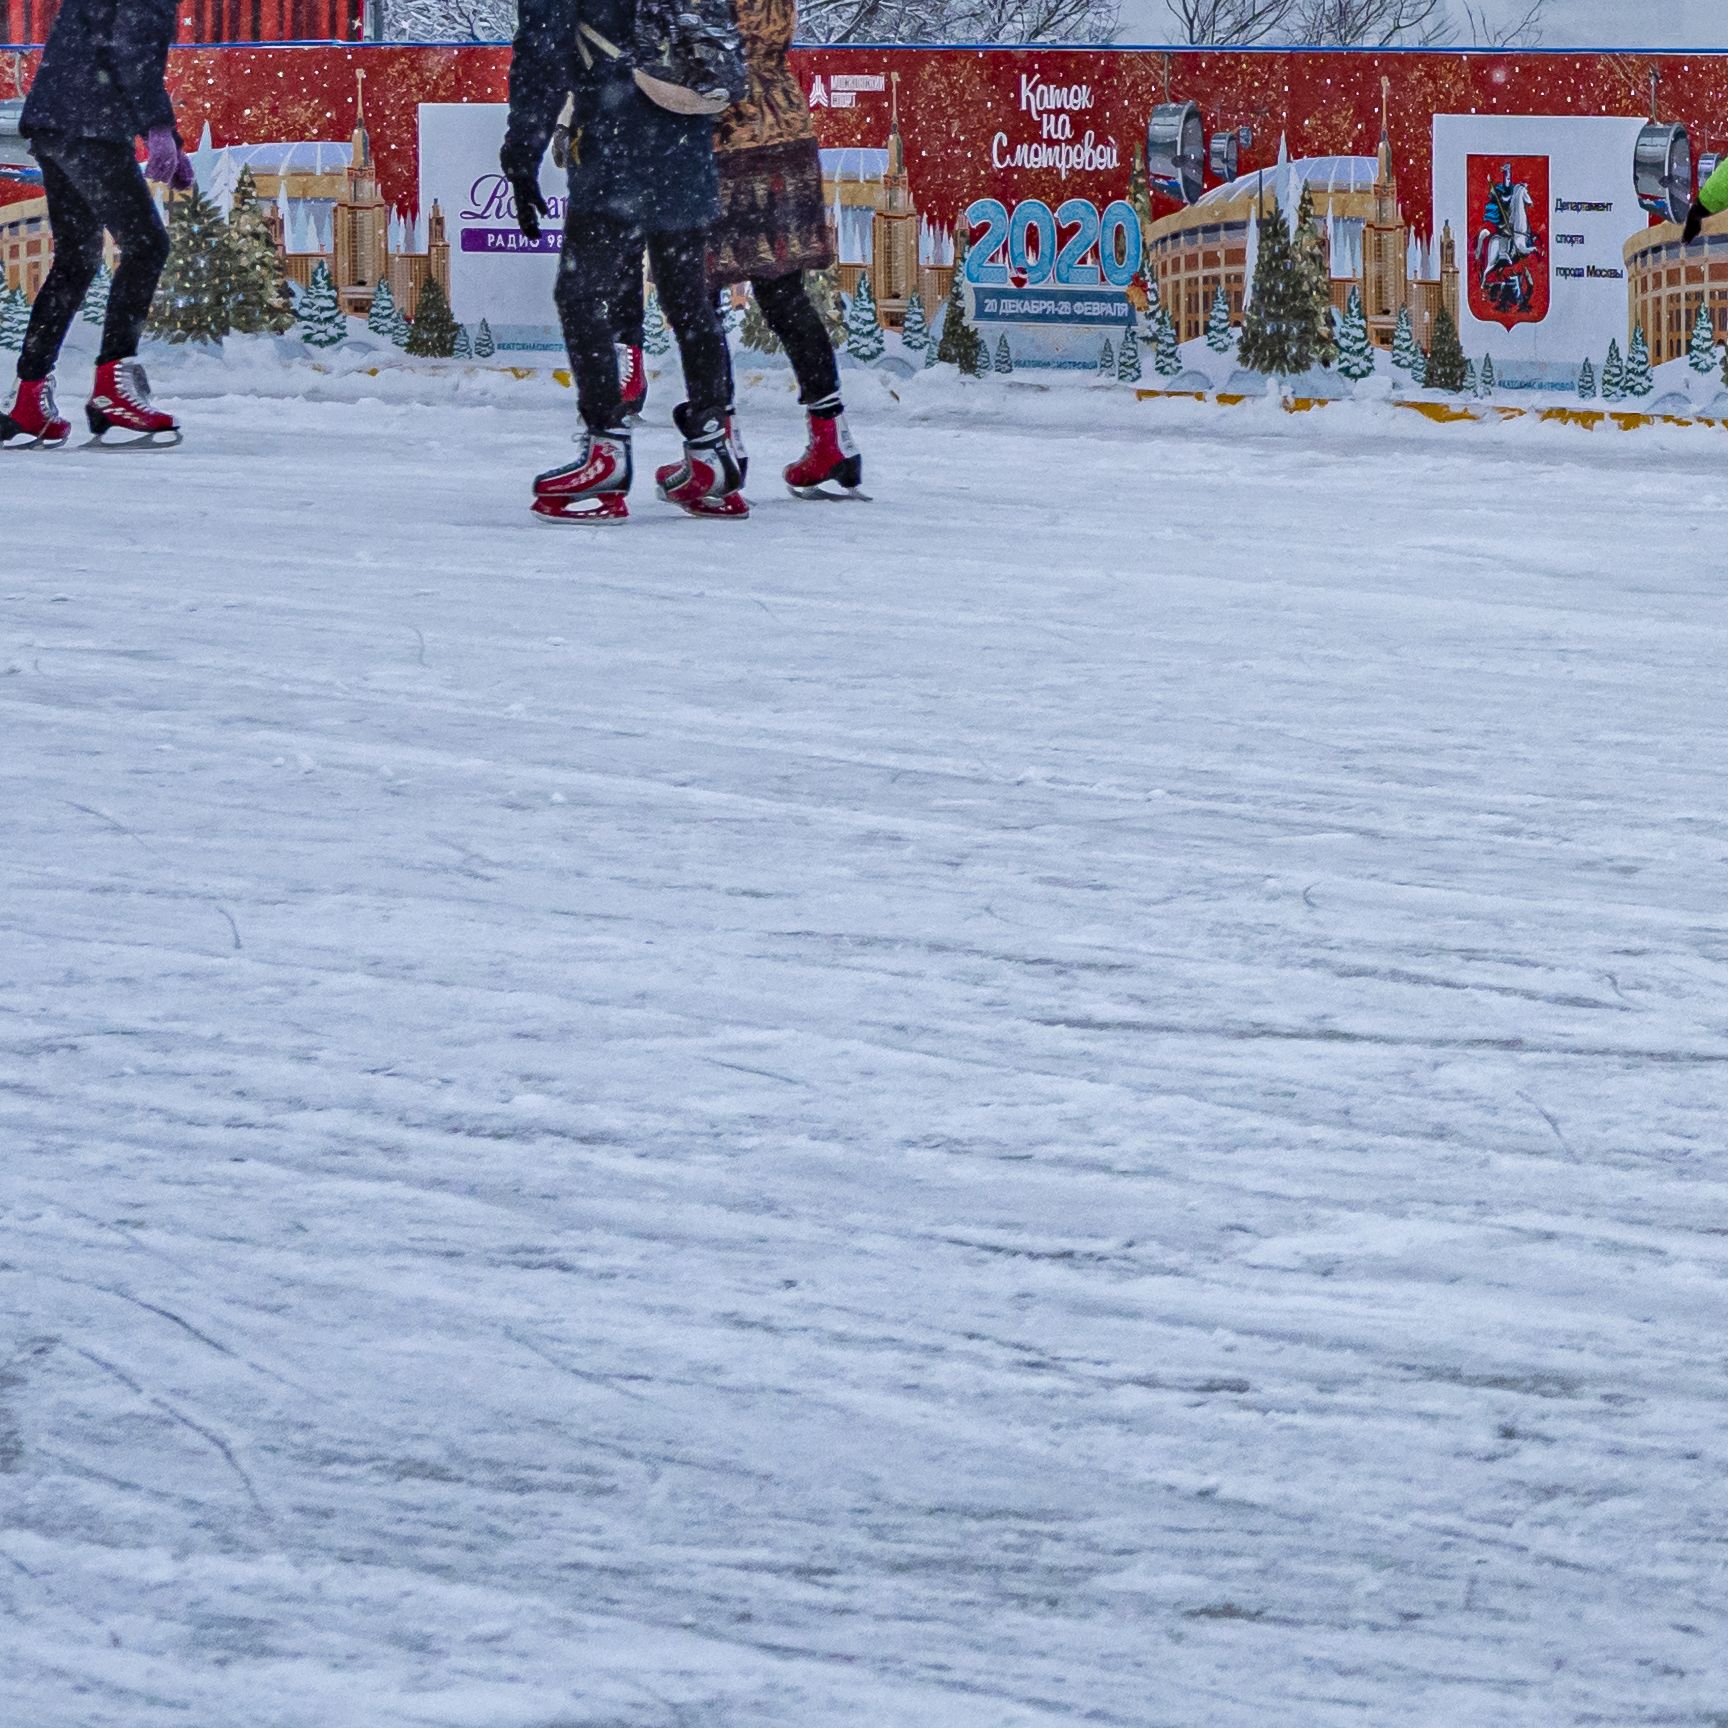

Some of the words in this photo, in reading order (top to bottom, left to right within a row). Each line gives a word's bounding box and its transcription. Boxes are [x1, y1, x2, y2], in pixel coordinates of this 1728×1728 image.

[1020, 73, 1094, 121] Каток
[1042, 113, 1074, 140] на
[993, 130, 1120, 180] Смотровой
[965, 198, 1142, 287] 2020
[1556, 234, 1584, 246] спорта
[984, 299, 998, 313] 20
[1072, 302, 1129, 317] ФЕВРАЛЯ
